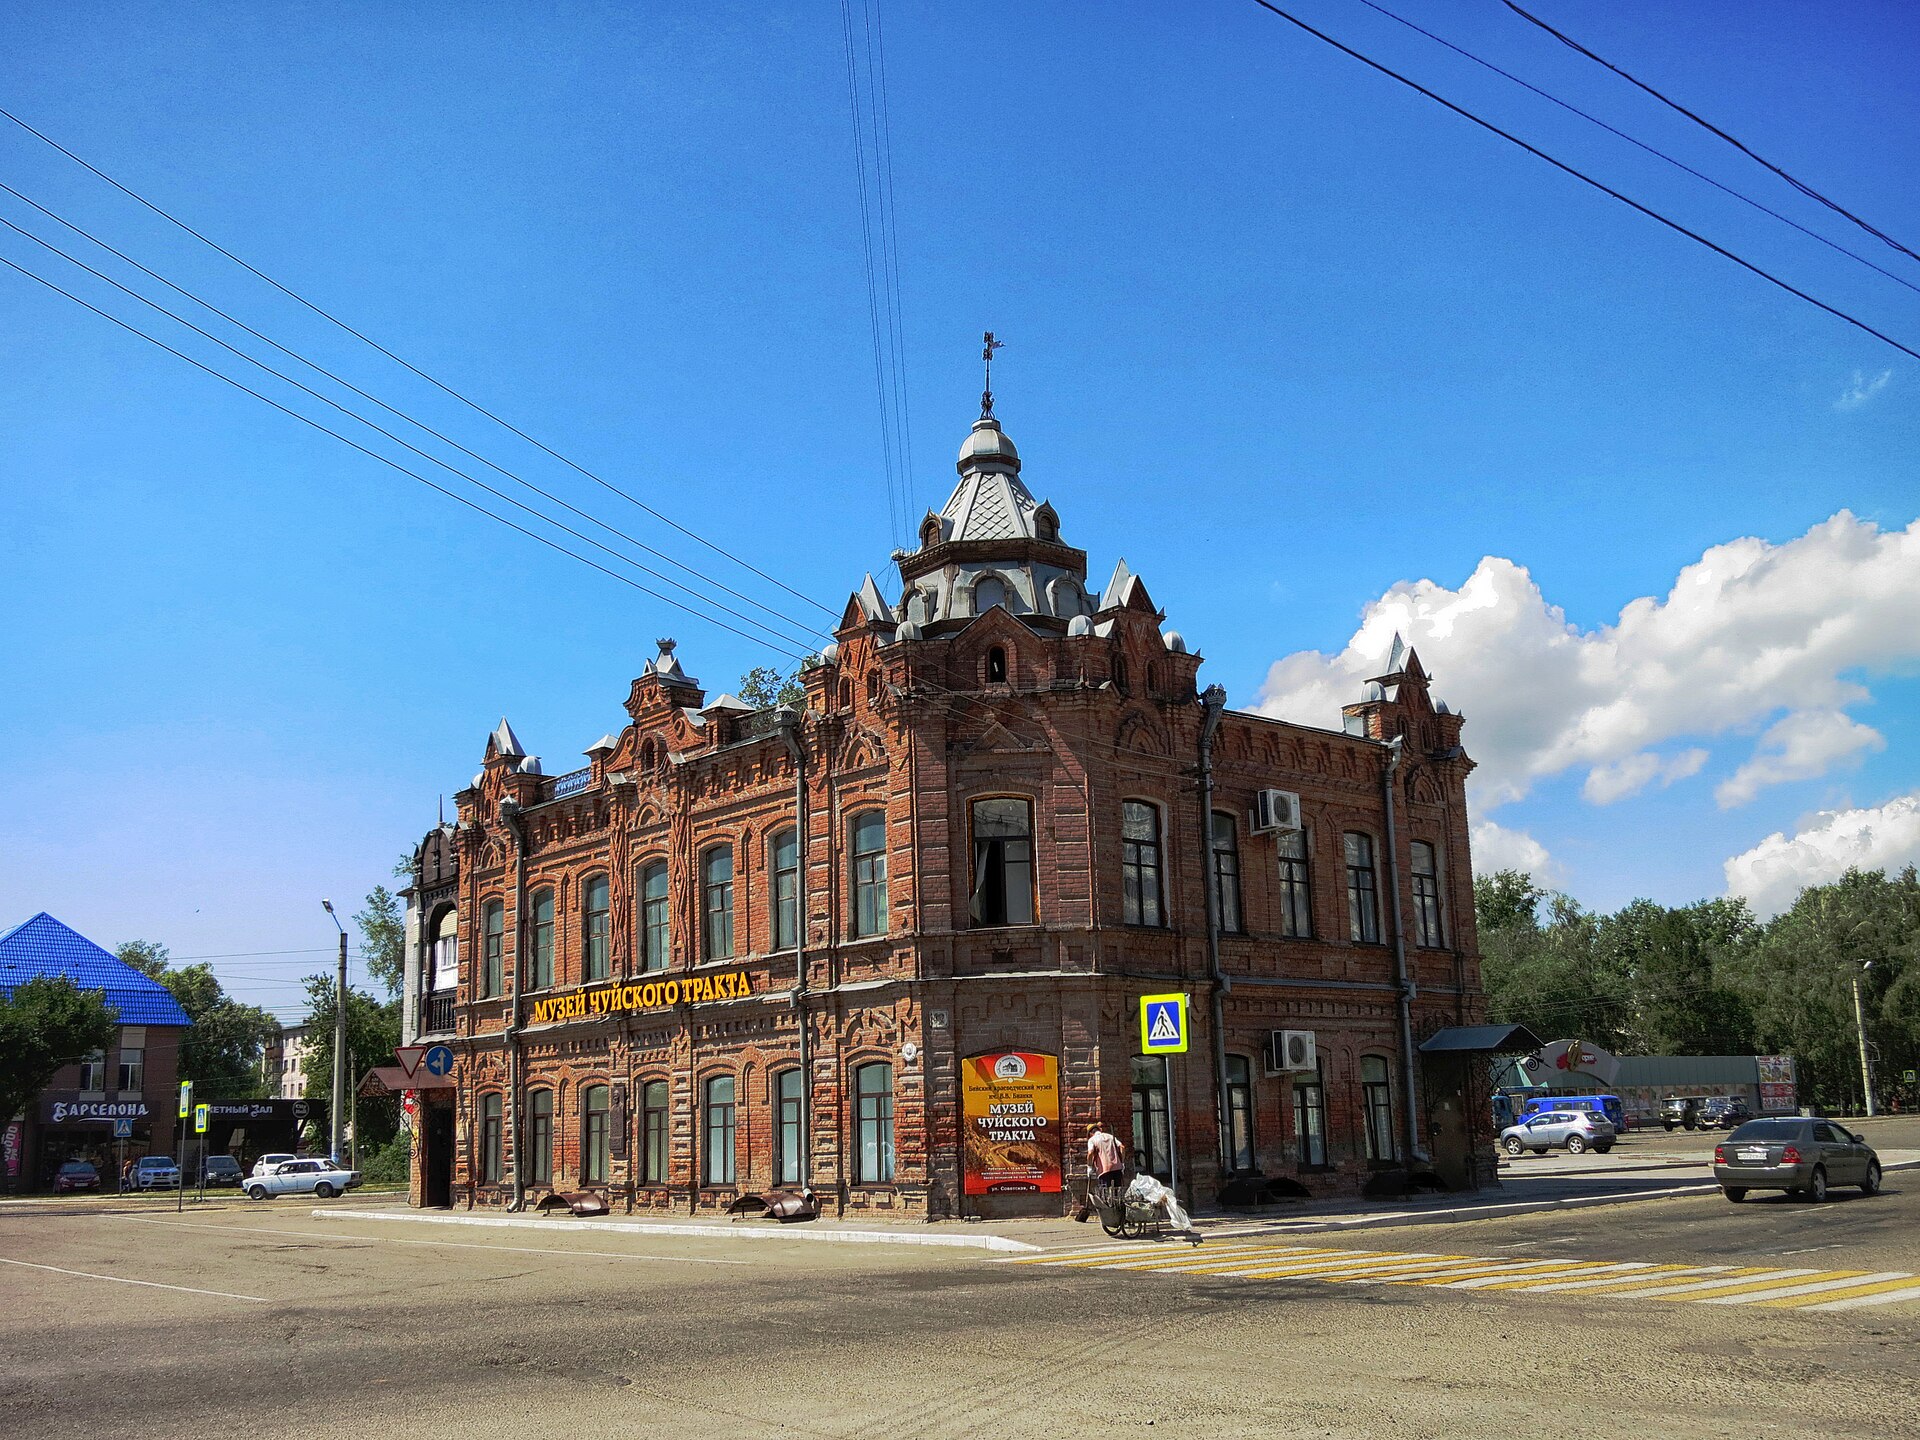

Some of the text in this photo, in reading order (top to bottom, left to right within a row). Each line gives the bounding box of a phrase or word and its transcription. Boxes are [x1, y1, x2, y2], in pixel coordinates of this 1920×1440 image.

[534, 971, 751, 1022] МУЗЕЙ ЧУЙСКОГО ТРАКТА
[989, 1100, 1034, 1115] МУЗЕЙ
[977, 1115, 1047, 1129] ЧУЙСКОГО
[988, 1130, 1036, 1141] ТРАКТА
